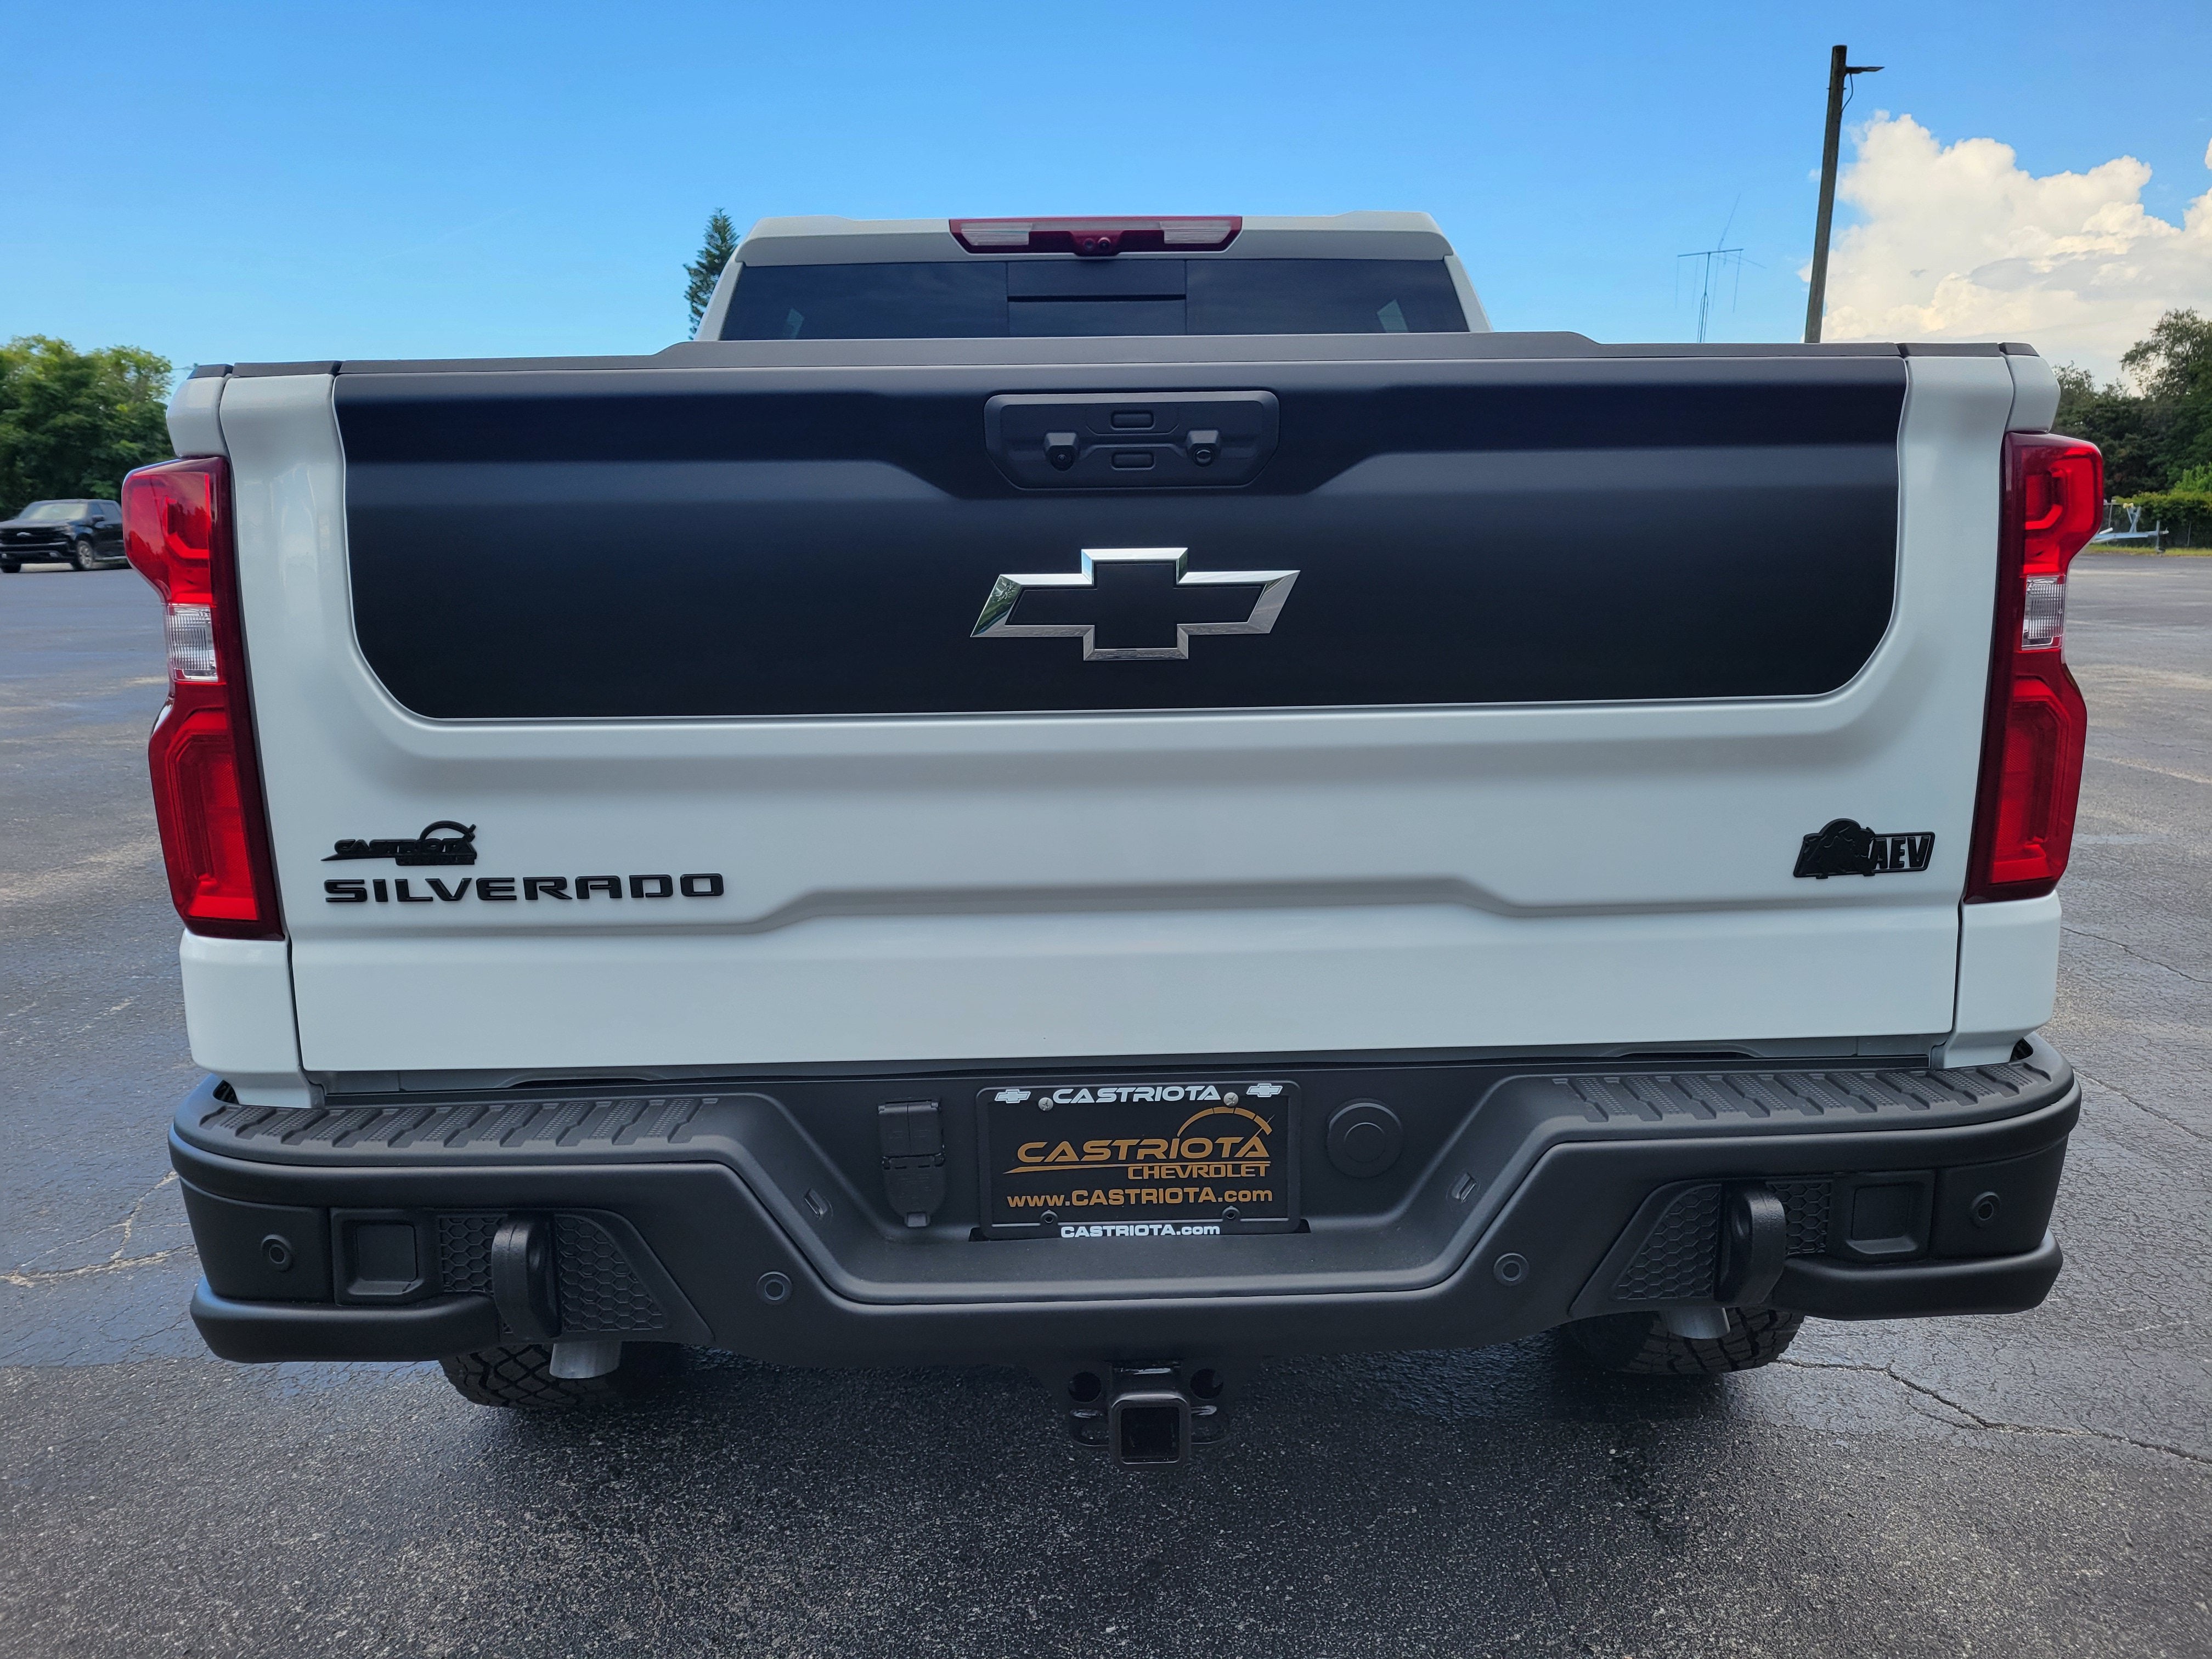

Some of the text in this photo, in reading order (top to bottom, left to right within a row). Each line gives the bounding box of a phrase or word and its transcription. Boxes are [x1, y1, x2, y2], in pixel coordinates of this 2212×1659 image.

[1871, 836, 1930, 869] AEV
[324, 873, 724, 903] SILVERADO
[1052, 1085, 1221, 1104] CASTRIOTA
[1017, 1136, 1270, 1163] CASTRIOTA
[1127, 1164, 1271, 1180] CHEVROLET
[1007, 1187, 1273, 1207] www.CASTRIOTA.com
[1060, 1224, 1221, 1238] CASTRIOTA.com
